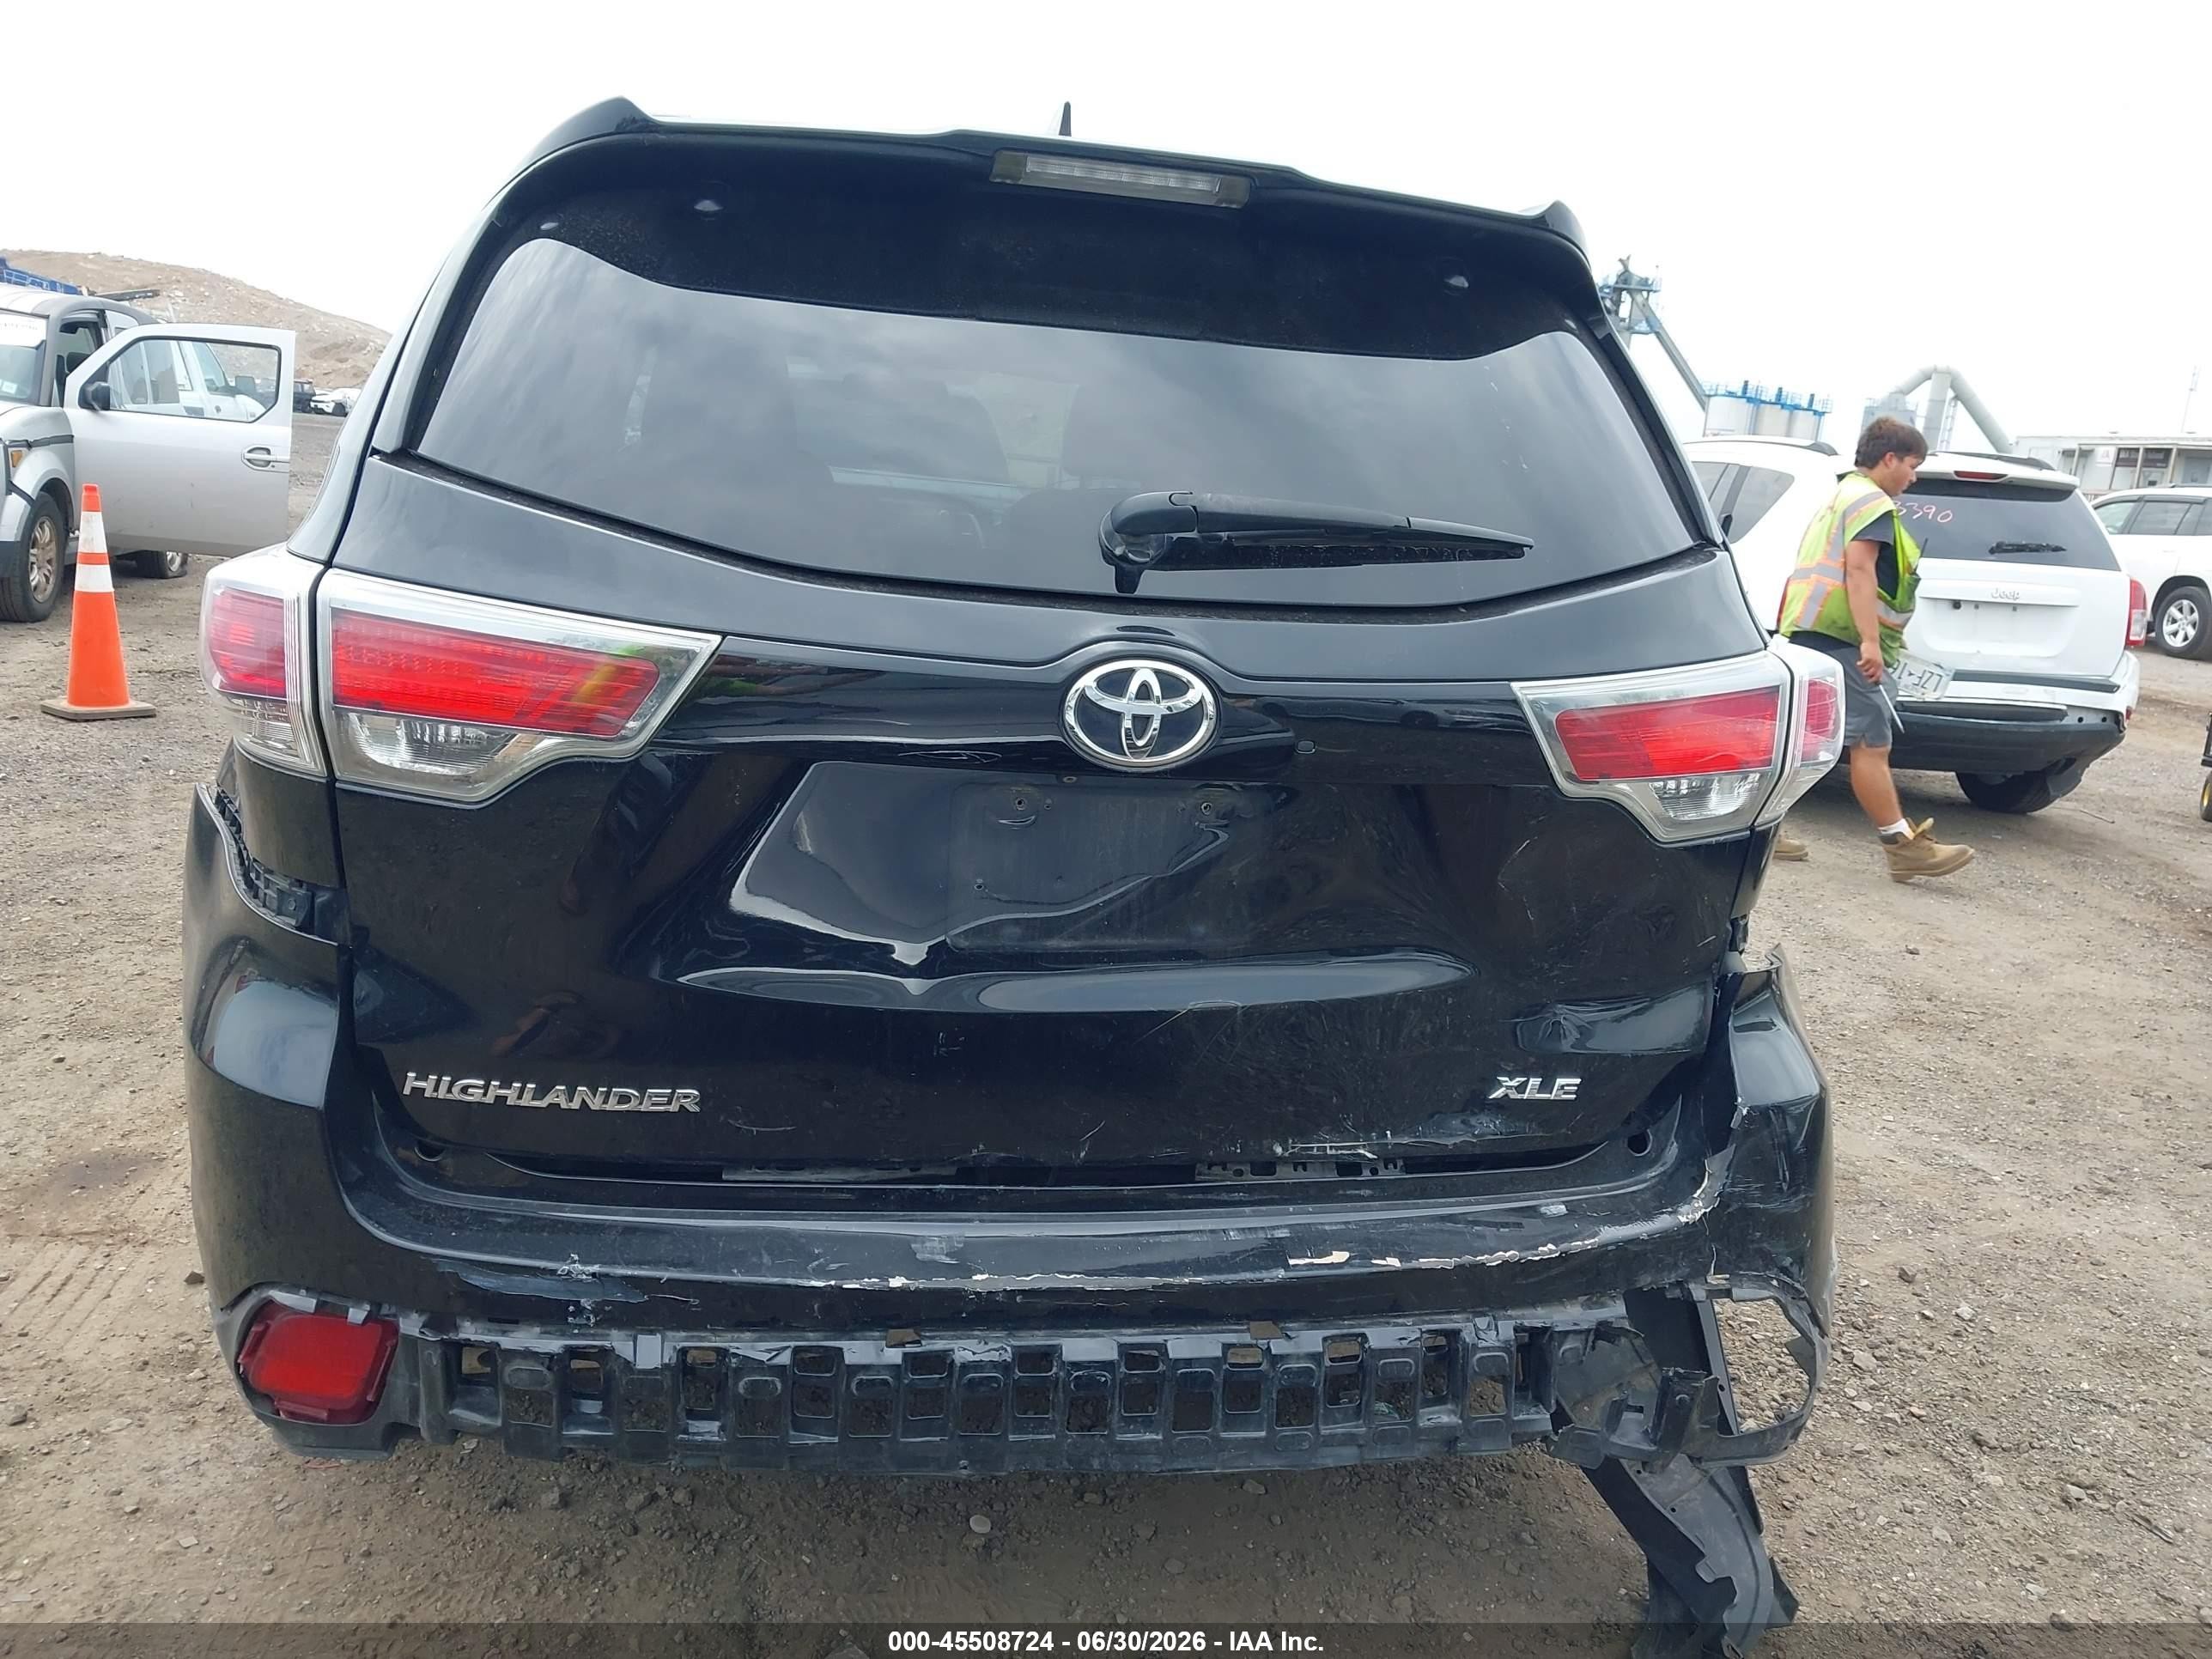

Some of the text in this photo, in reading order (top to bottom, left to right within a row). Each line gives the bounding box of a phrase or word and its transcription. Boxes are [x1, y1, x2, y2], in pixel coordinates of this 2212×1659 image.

[1990, 586, 2021, 601] Jeep
[402, 1072, 702, 1113] HIGHLANDER
[1488, 1077, 1583, 1100] XLE
